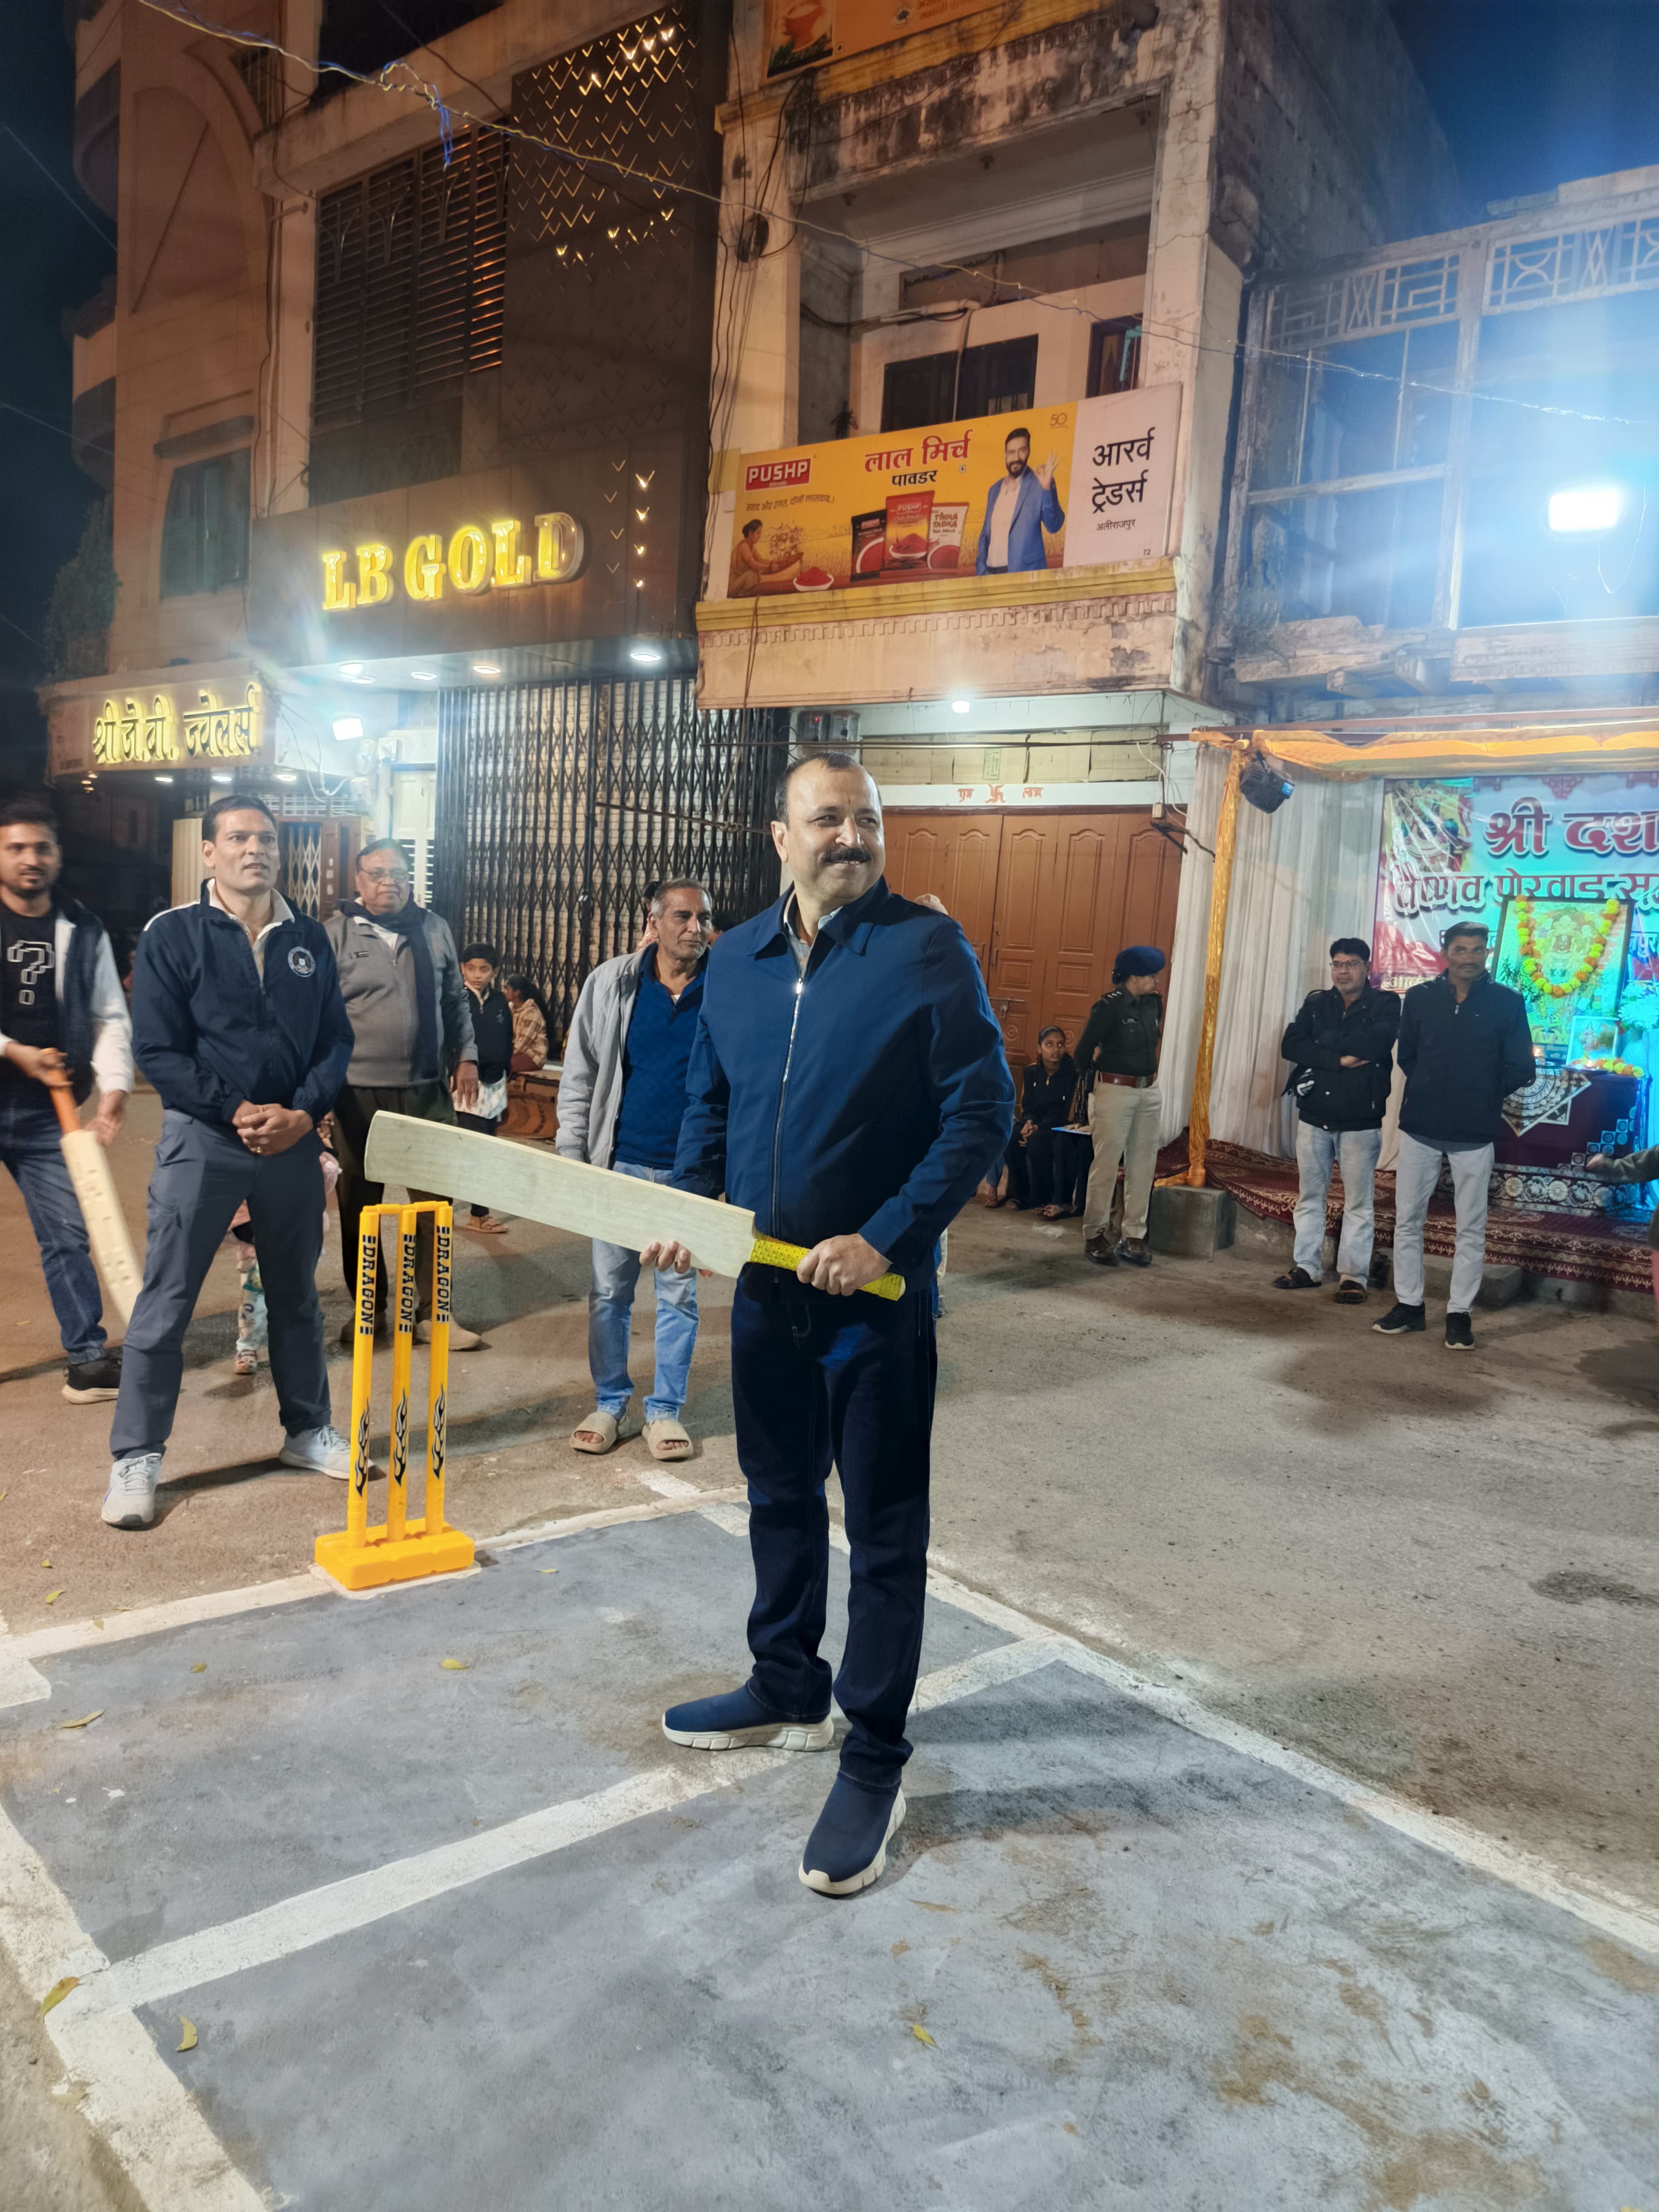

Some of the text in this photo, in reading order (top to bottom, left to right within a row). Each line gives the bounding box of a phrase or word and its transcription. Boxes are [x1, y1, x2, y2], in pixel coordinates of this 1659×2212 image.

[749, 462, 808, 483] PUSHP
[865, 429, 973, 472] लाल मिर्च
[892, 470, 938, 486] पावडर
[1092, 469, 1148, 514] ट्रेडर्स
[935, 511, 958, 521] TIKHA
[1097, 519, 1136, 531] अलीराजपुर
[322, 511, 584, 610] LB GOLD
[93, 700, 122, 764] श्री
[1485, 796, 1551, 855] श्री
[361, 1244, 376, 1325] DRAGON
[400, 1244, 415, 1323] DRAGON
[437, 1234, 450, 1312] DRAGON
